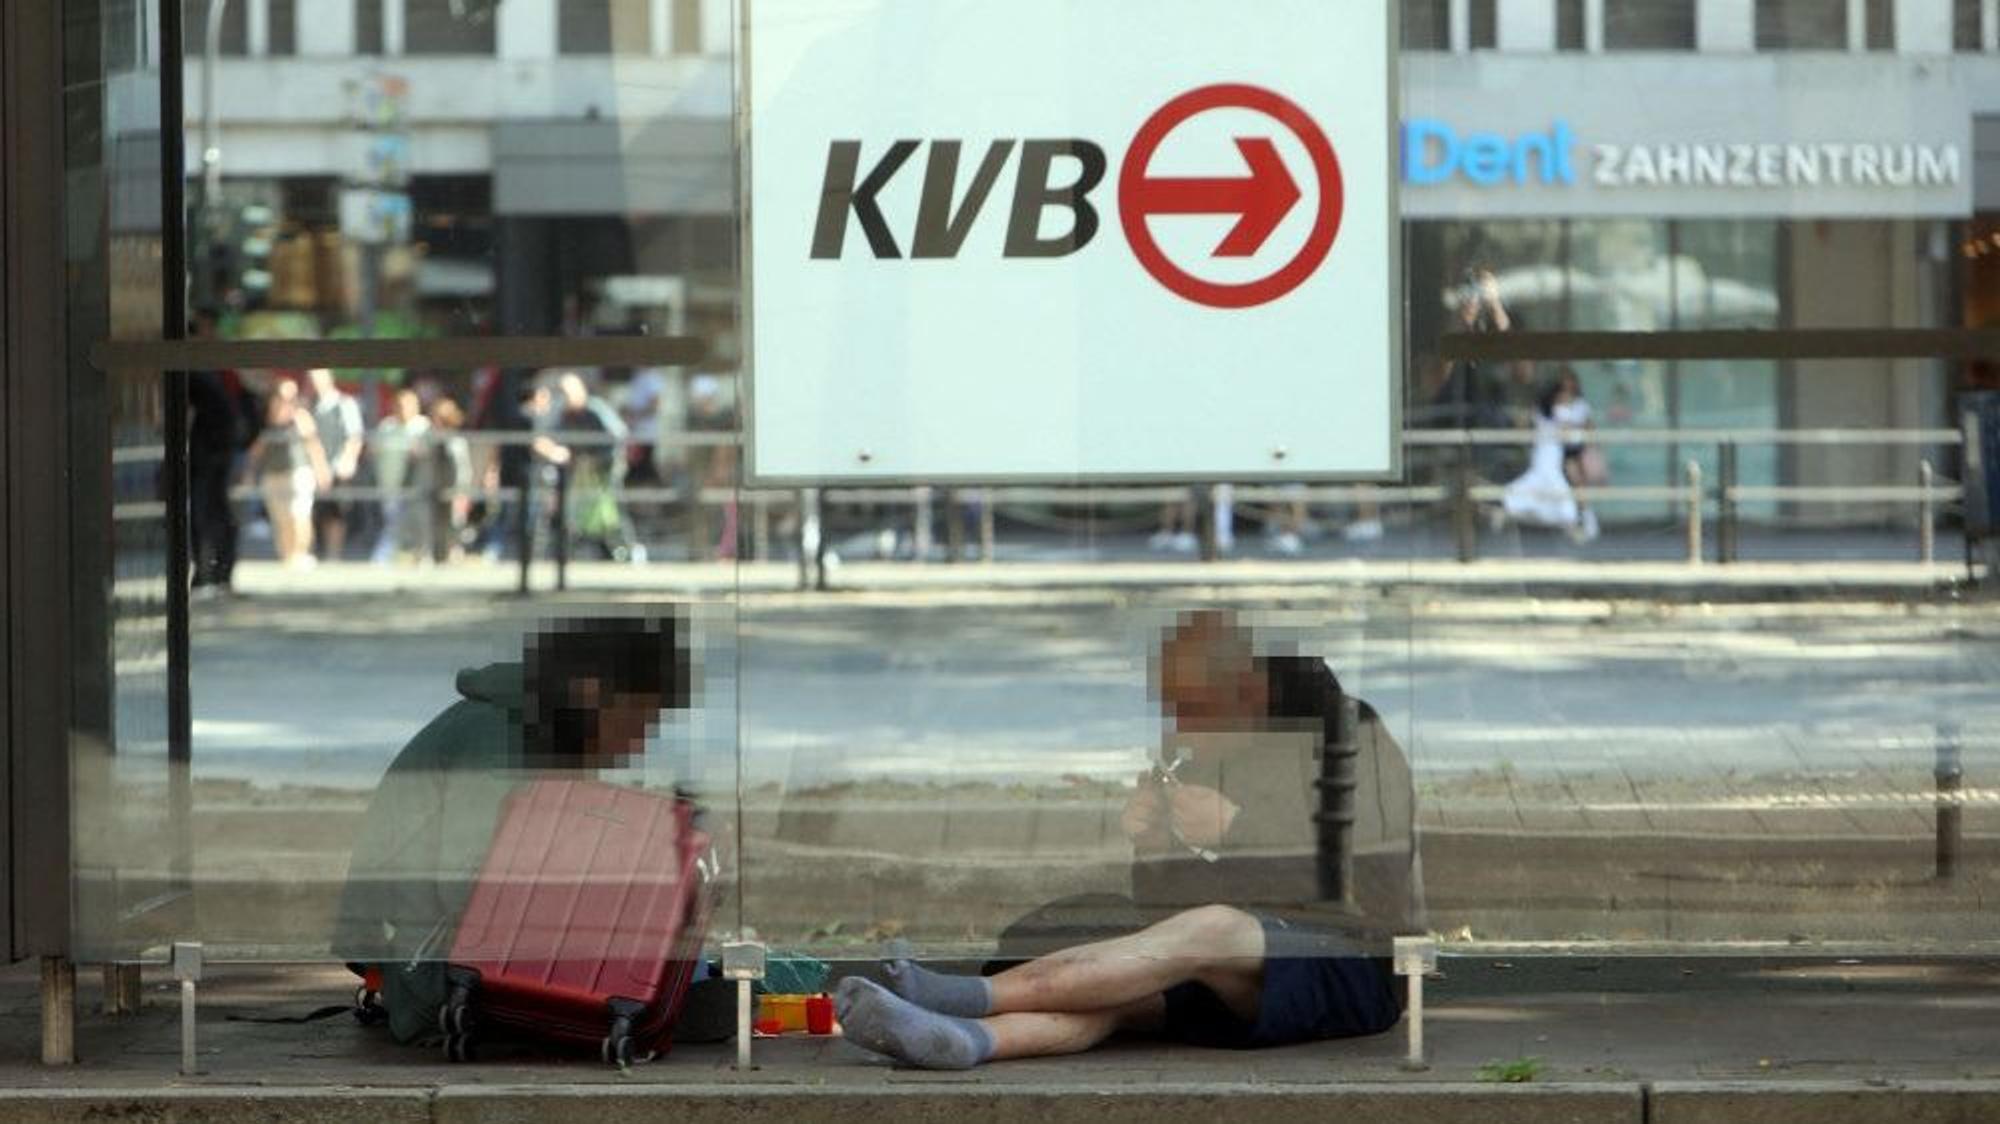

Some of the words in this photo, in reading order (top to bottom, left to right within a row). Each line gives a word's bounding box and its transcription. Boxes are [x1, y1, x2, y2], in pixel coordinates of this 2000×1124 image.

[810, 138, 1107, 260] KVB
[1400, 118, 1577, 186] Dent
[1594, 143, 1960, 187] ZAHNZENTRUM
